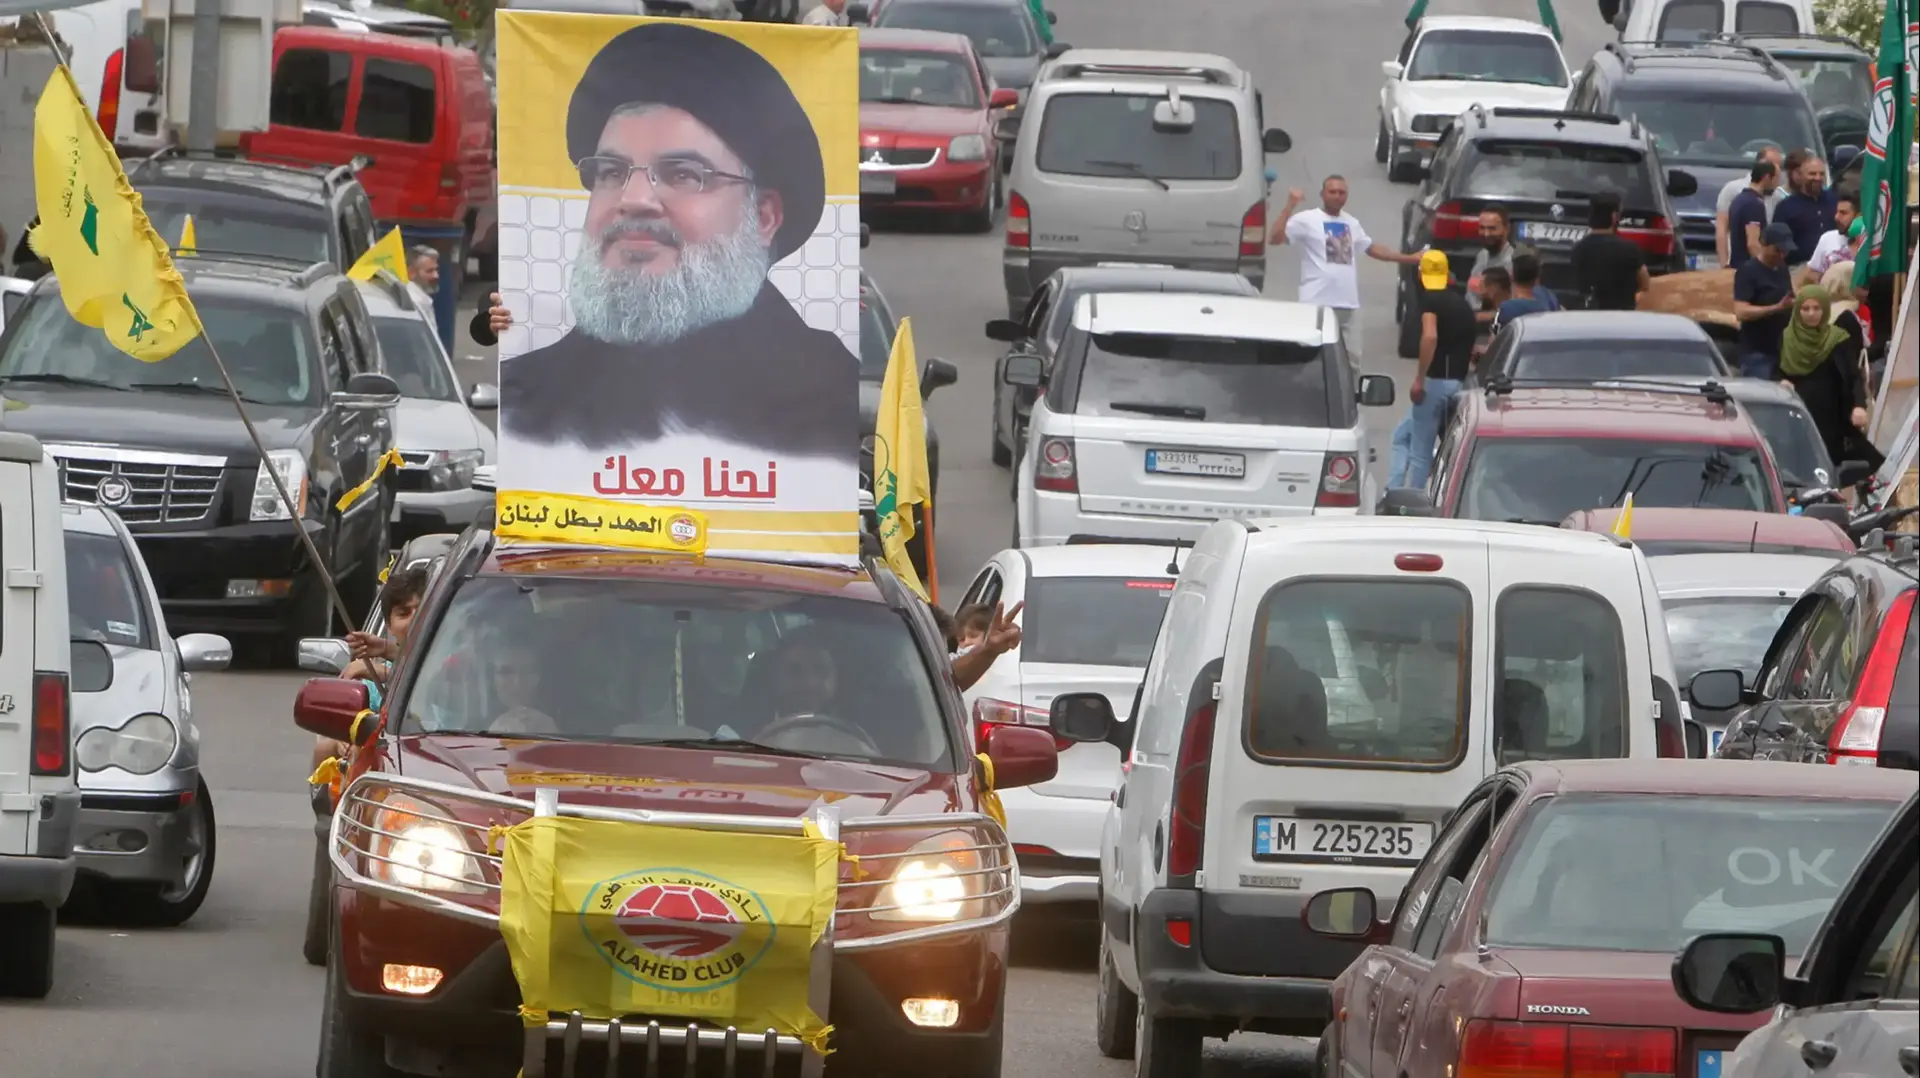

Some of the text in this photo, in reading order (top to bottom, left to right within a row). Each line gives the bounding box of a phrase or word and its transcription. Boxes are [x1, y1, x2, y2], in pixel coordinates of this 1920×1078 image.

[593, 455, 777, 499] نحنا معك
[500, 503, 550, 528] لبنان
[554, 508, 603, 529] بطل
[609, 516, 662, 534] العهد
[1276, 822, 1413, 855] M 225235
[1727, 847, 1839, 887] OK
[719, 888, 761, 922] نادي
[602, 939, 746, 981] ALAHED CLUB
[1527, 1004, 1590, 1015] HONDA
